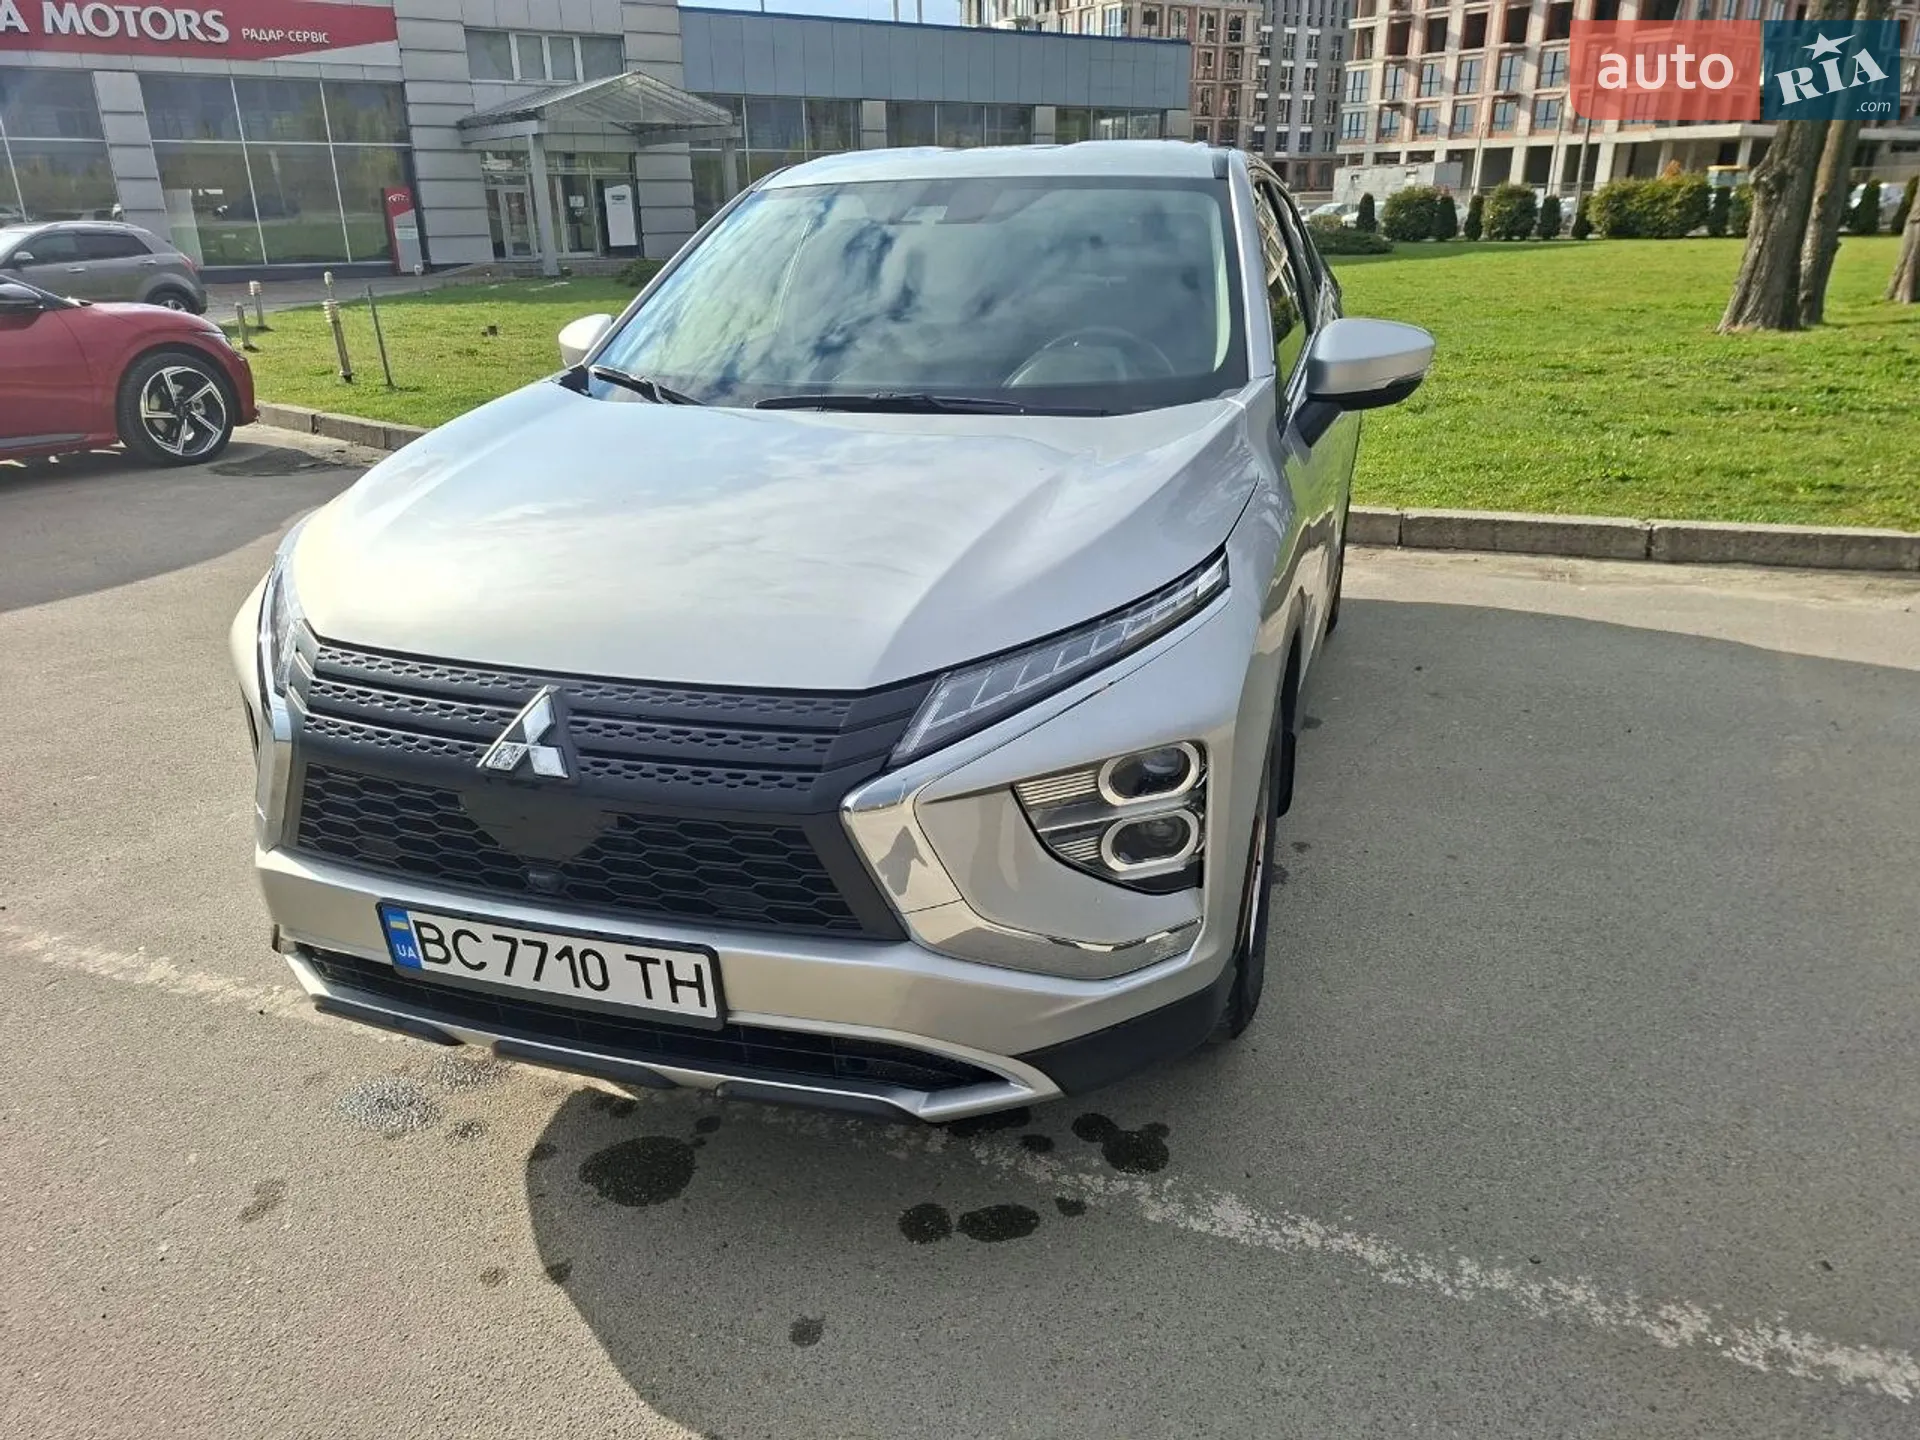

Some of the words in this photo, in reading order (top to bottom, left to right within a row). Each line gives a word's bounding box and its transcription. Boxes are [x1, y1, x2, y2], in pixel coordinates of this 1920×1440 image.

[42, 1, 230, 44] MOTORS
[396, 943, 417, 960] UA
[625, 954, 708, 1009] TH
